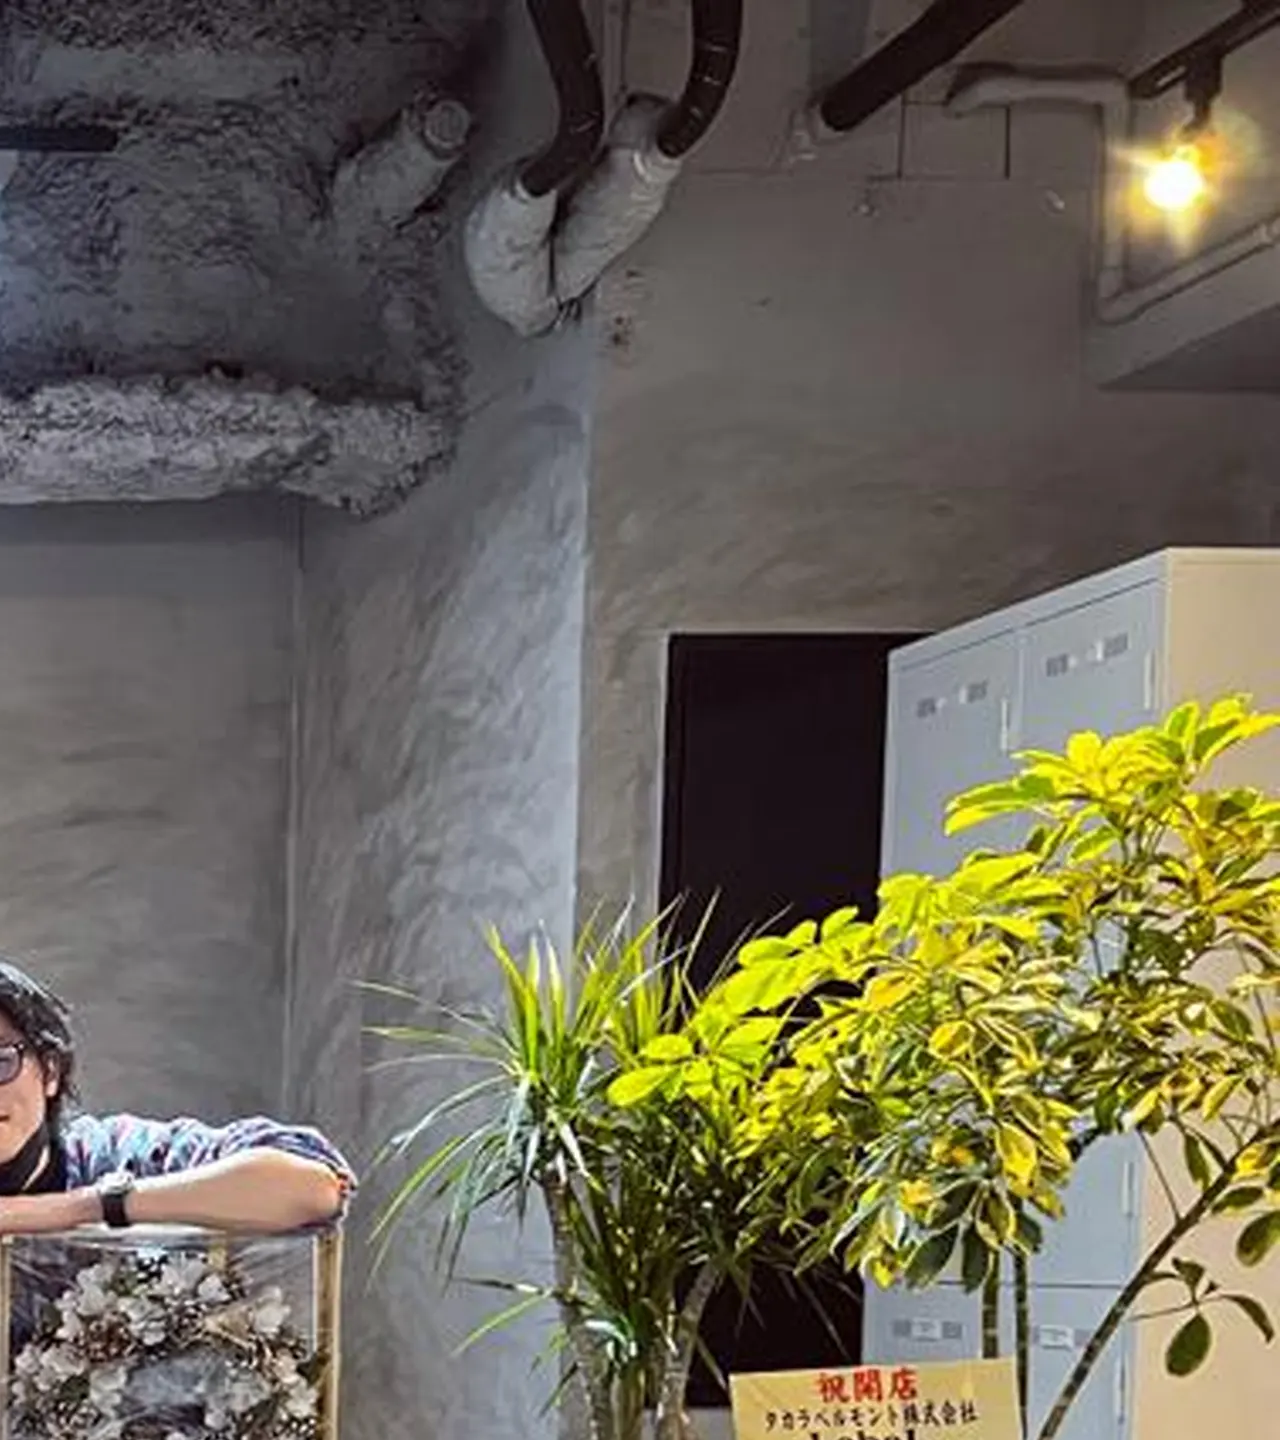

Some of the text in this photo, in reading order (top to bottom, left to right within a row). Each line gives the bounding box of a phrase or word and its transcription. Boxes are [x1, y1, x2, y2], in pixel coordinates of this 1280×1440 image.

[818, 1367, 918, 1403] 祝開店
[765, 1399, 980, 1432] タカラベルモント株式会社
